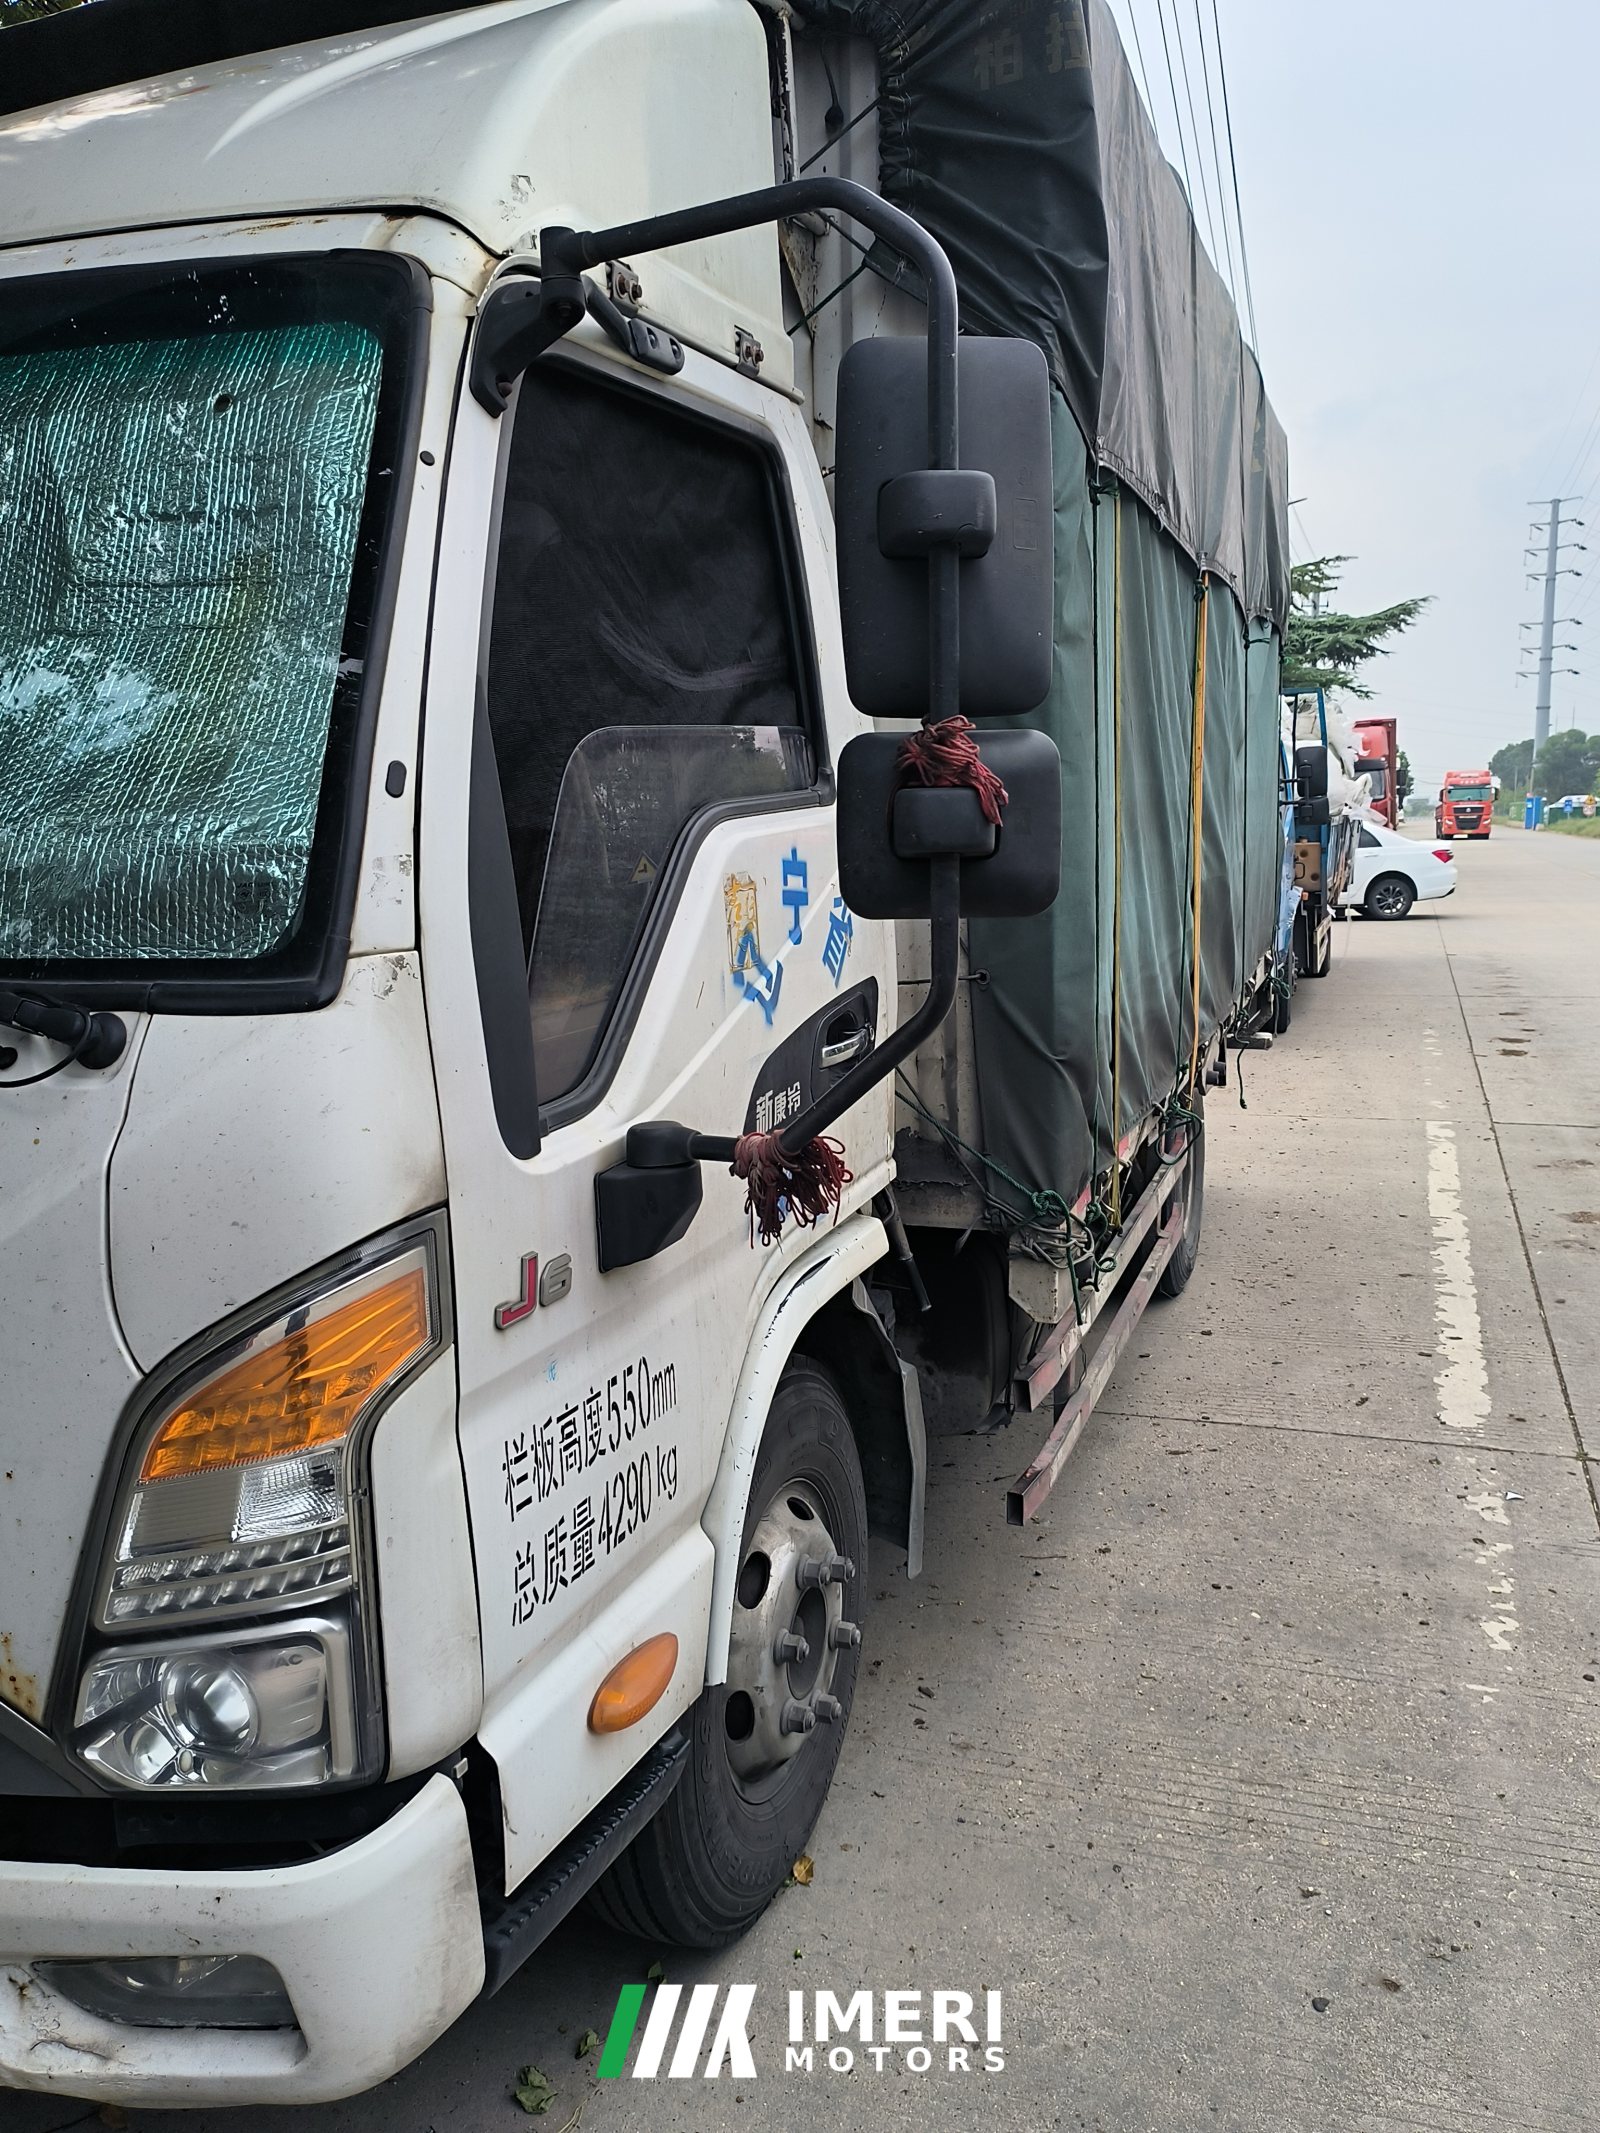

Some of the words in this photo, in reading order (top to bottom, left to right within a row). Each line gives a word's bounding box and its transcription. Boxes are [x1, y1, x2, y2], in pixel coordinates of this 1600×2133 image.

[495, 1251, 572, 1330] J6
[502, 1356, 678, 1522] 栏板高度550mm
